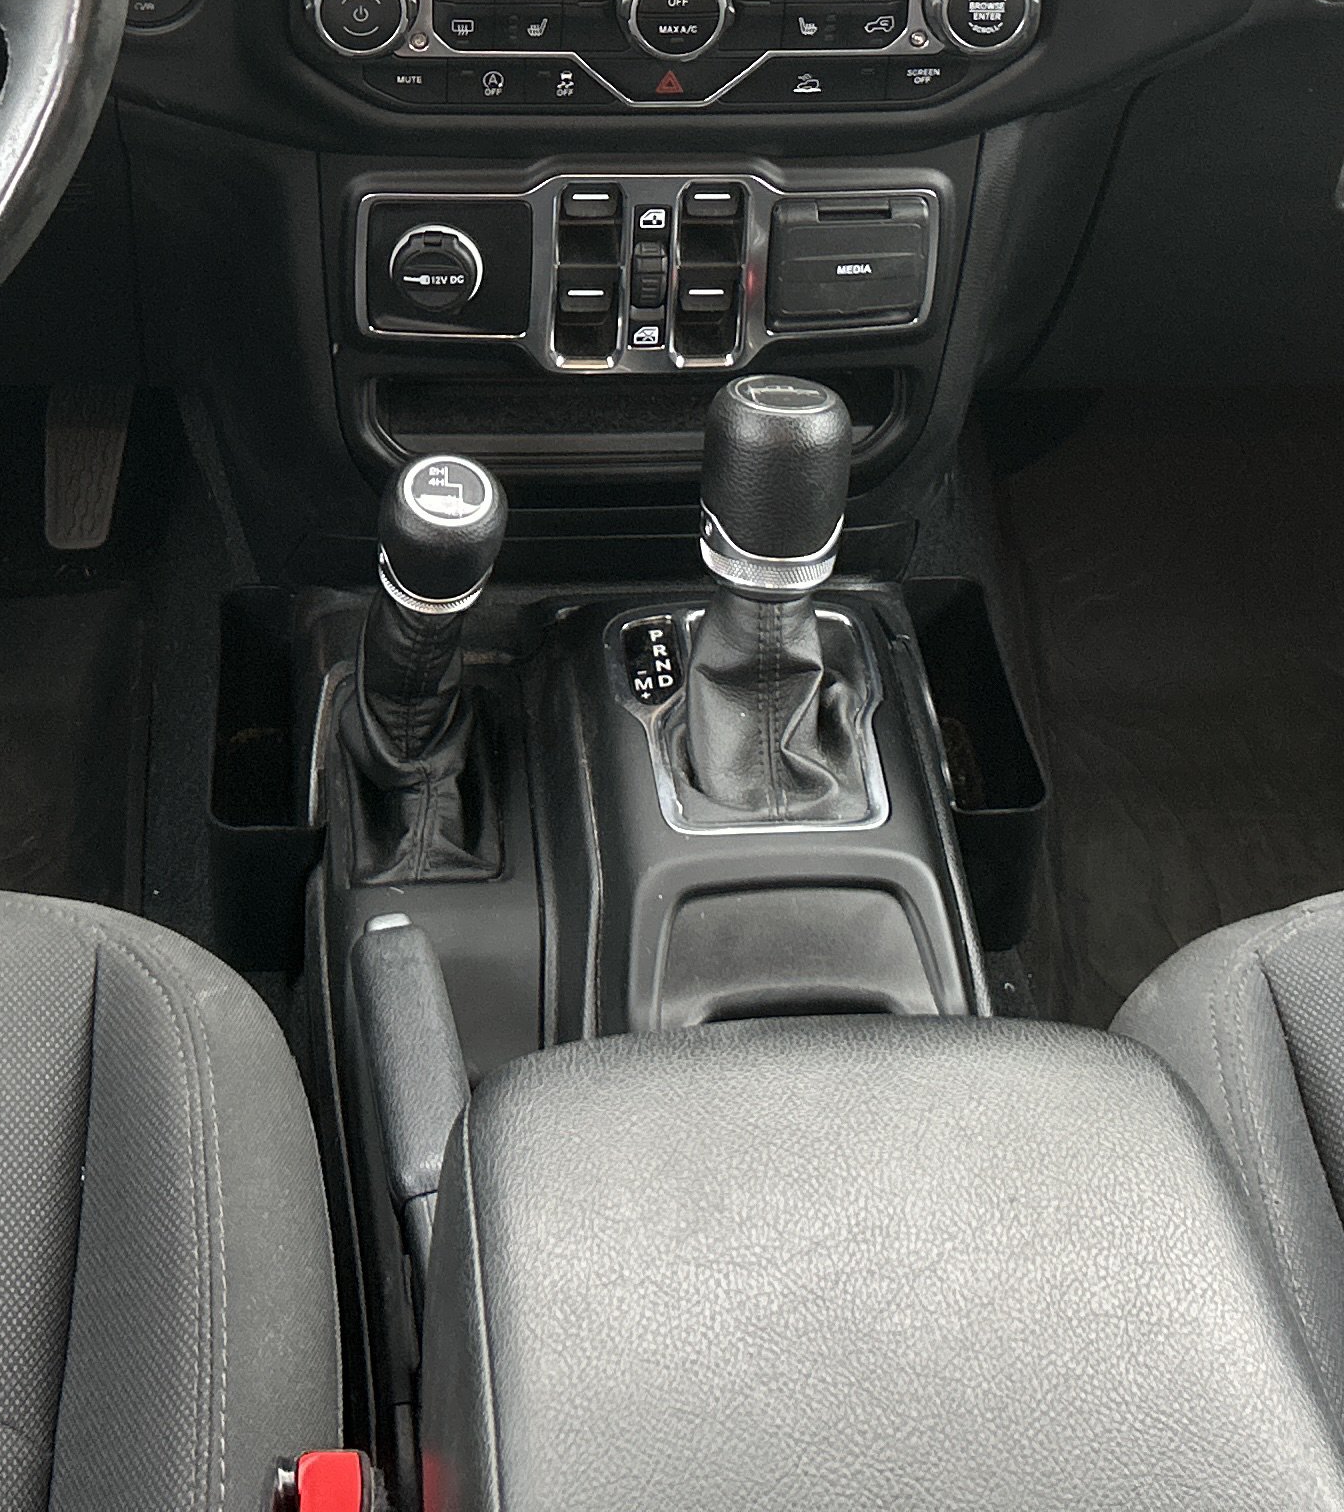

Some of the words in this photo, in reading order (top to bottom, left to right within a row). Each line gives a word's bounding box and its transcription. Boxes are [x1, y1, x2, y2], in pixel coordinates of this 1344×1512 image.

[969, 2, 1005, 10] BROWSE
[973, 12, 1002, 21] ENTER
[659, 25, 679, 34] MAX
[680, 24, 698, 35] A/C
[906, 68, 941, 77] SCREEN
[397, 75, 423, 85] MUTE
[913, 76, 932, 85] OFF
[484, 87, 502, 97] OFF
[556, 88, 574, 97] OFF
[836, 262, 873, 275] MEDIA
[431, 275, 448, 285] 12V
[449, 274, 465, 285] DC
[427, 477, 445, 486] 4H
[647, 629, 664, 642] P
[652, 644, 668, 657] R
[655, 659, 672, 672] N
[634, 676, 654, 691] M
[658, 674, 674, 687] D
